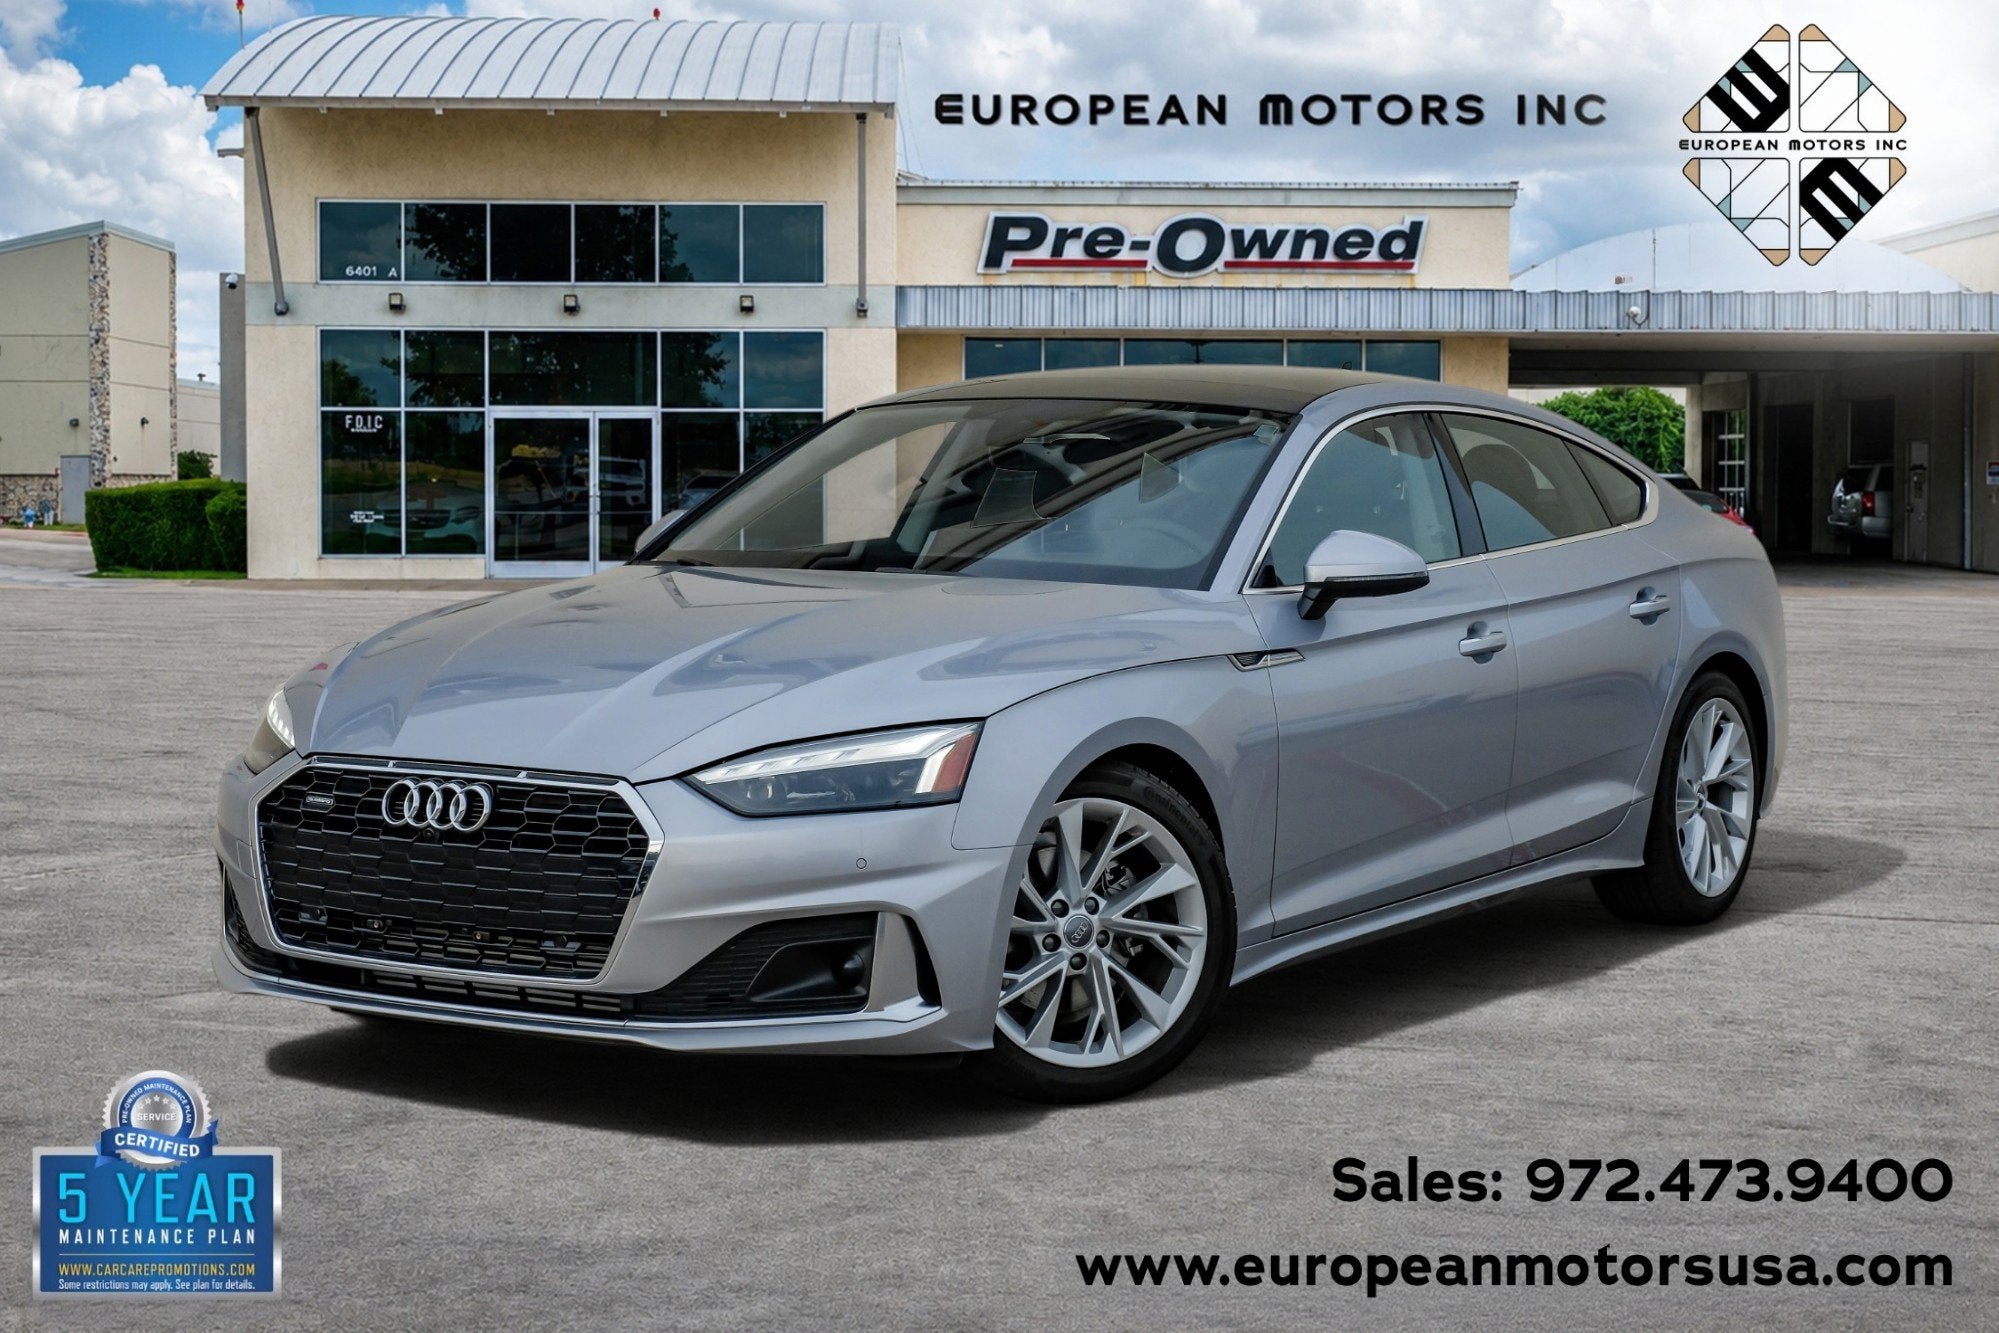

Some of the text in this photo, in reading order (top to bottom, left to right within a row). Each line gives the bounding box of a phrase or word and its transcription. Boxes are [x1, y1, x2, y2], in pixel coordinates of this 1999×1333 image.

[983, 216, 1424, 272] Pre-Owned
[345, 265, 398, 278] 6401 A
